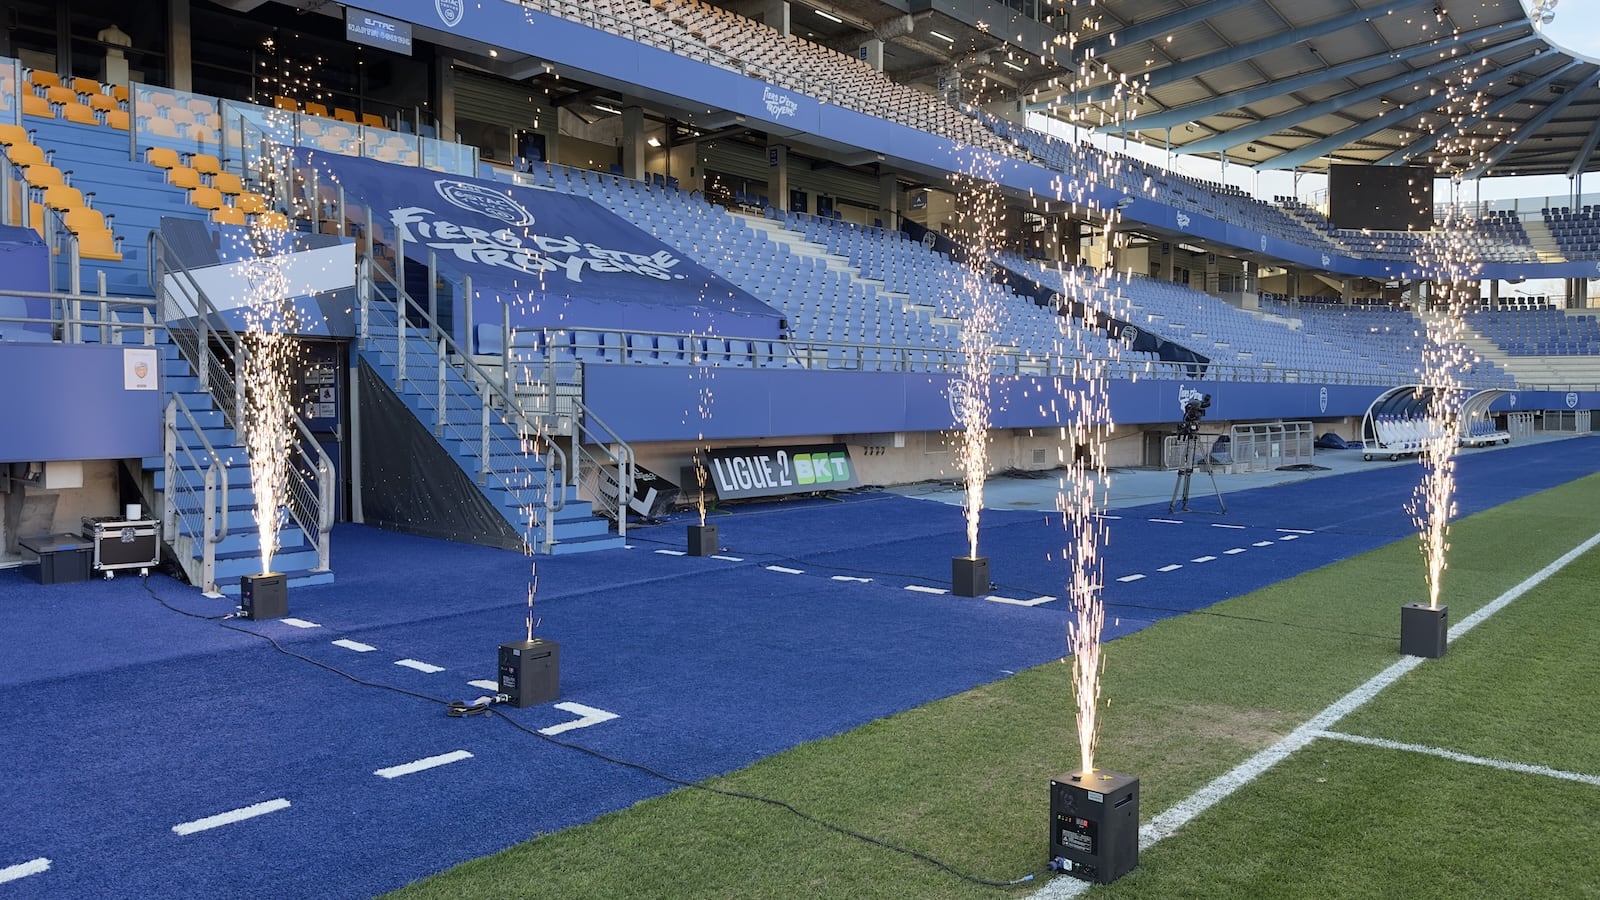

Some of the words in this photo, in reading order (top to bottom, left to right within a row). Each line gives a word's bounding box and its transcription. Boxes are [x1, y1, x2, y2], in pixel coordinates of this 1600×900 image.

[389, 206, 524, 249] FIERS
[713, 455, 778, 492] LIGUE
[776, 450, 793, 487] 2
[795, 457, 846, 480] BKT
